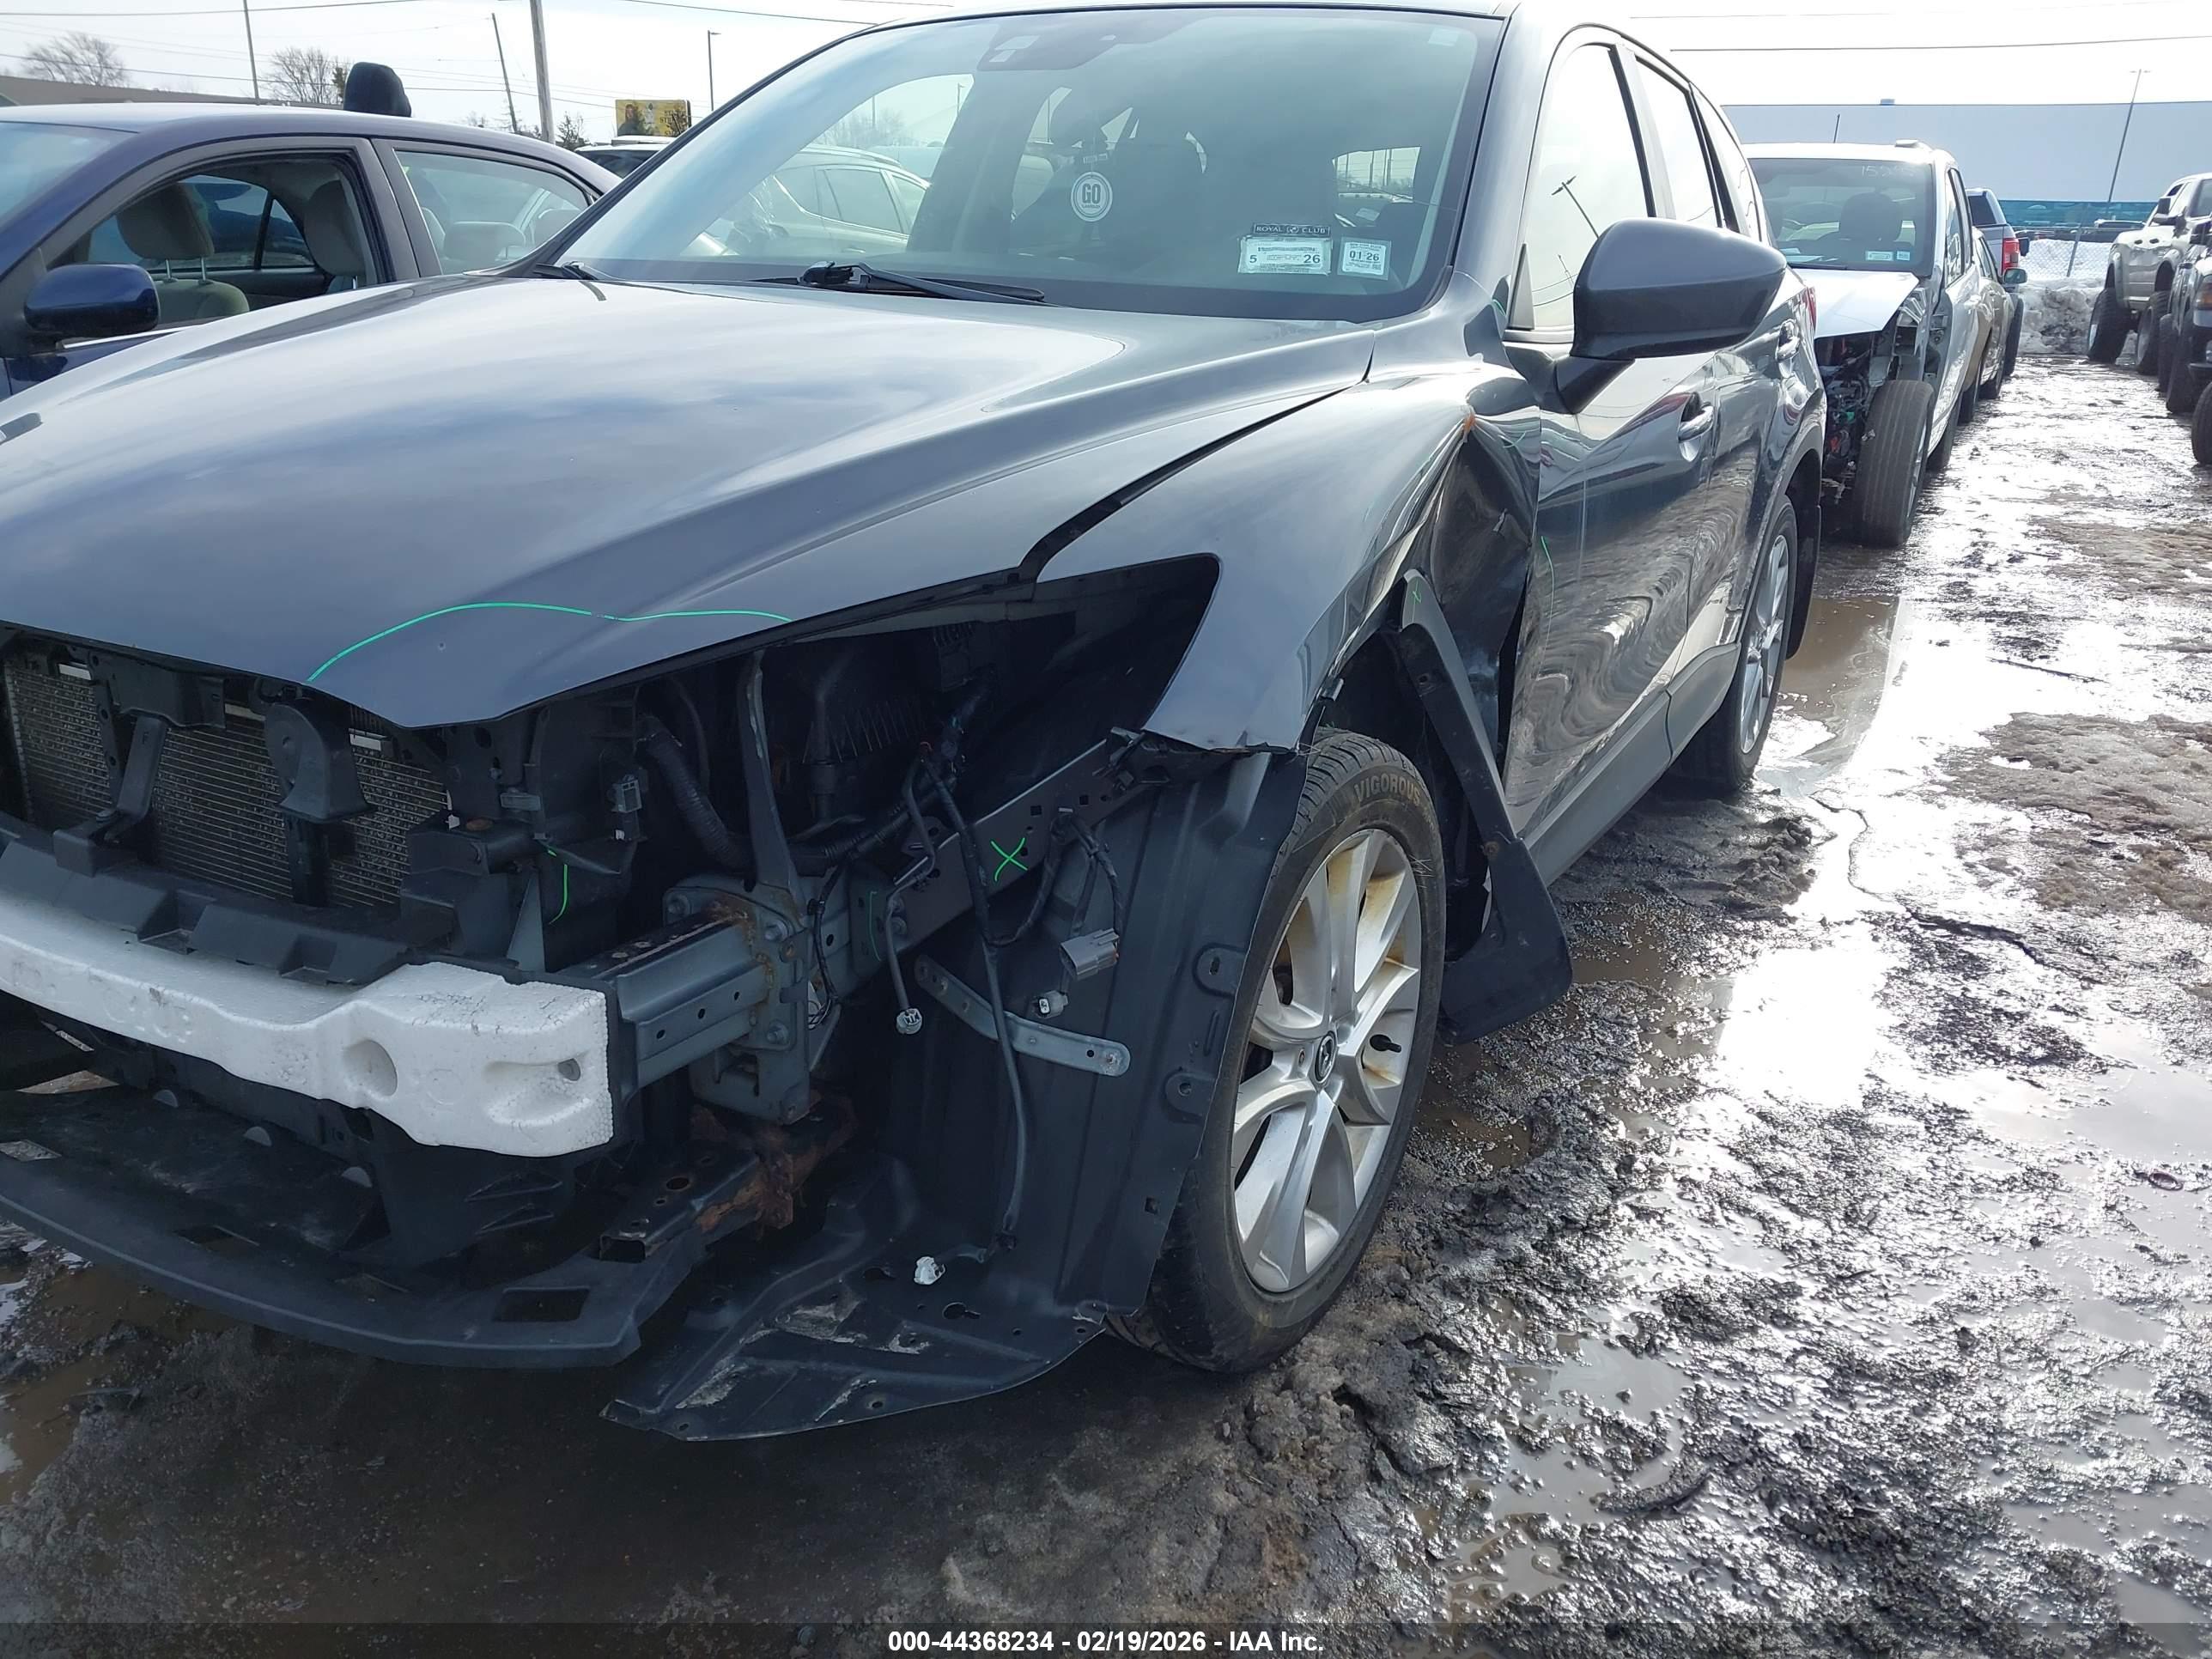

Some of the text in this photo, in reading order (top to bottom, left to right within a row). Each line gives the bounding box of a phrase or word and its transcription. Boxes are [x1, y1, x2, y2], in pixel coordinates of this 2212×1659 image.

[1082, 183, 1101, 204] GO
[1249, 254, 1257, 264] 5
[1304, 254, 1321, 264] 26
[1354, 773, 1420, 806] VIGOROUS
